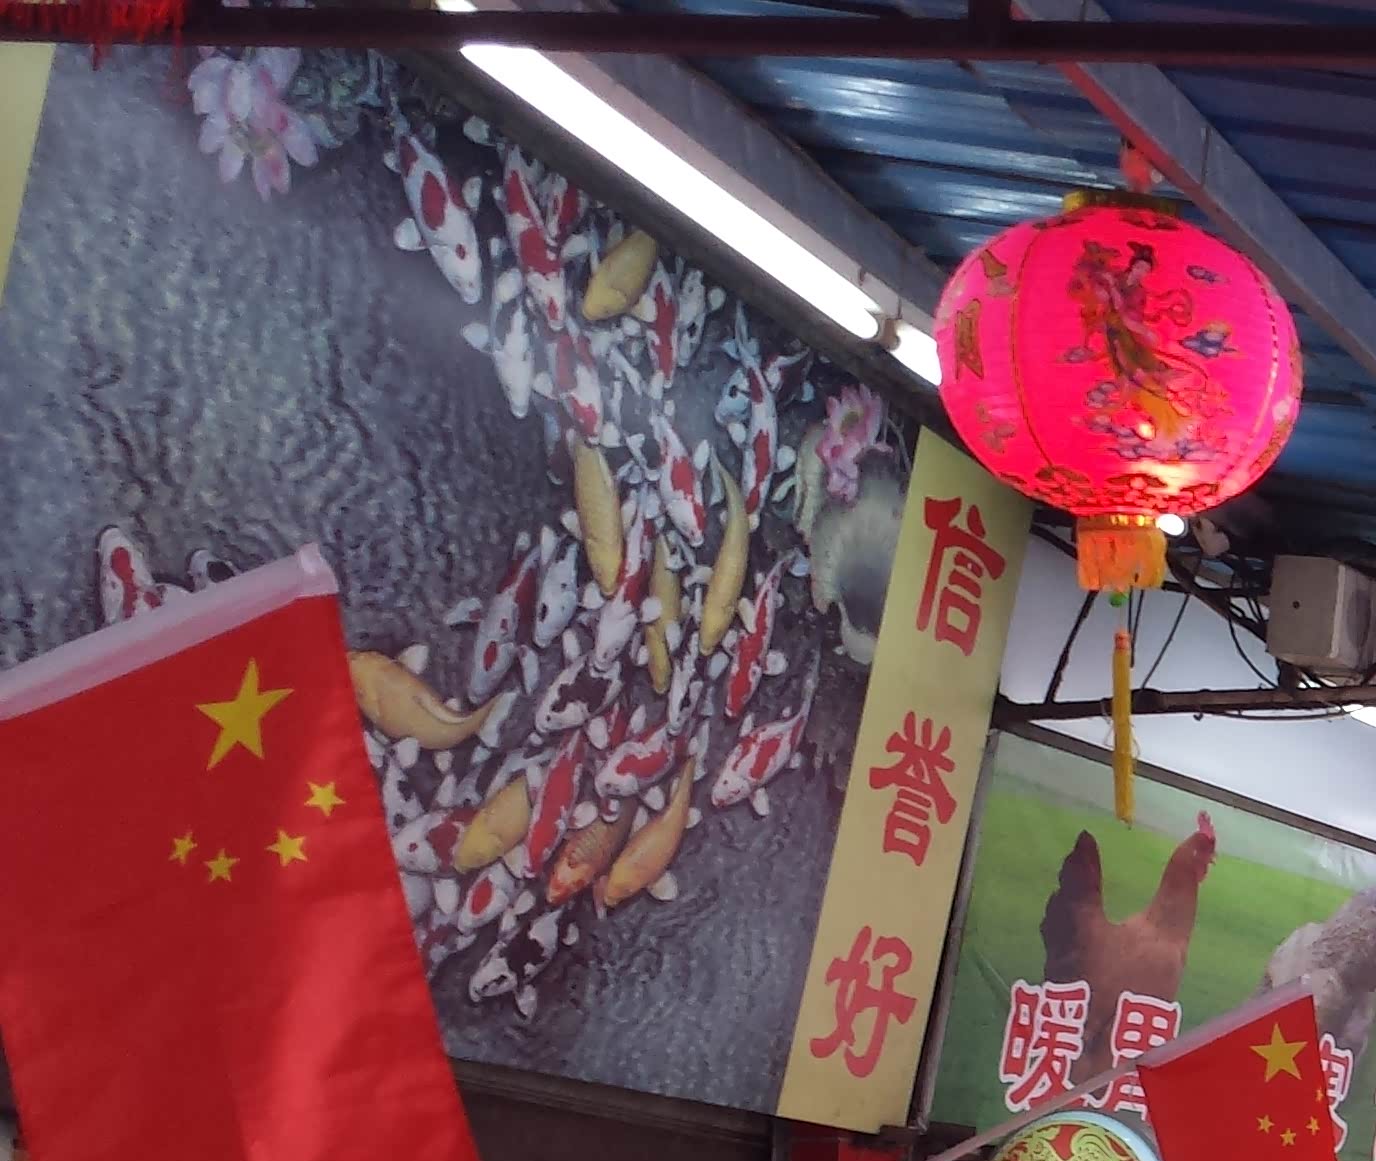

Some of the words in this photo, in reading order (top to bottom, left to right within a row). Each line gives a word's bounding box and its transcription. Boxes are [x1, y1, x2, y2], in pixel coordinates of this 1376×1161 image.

[808, 494, 1008, 1079] 信誉好
[999, 978, 1354, 1153] 暖胃
